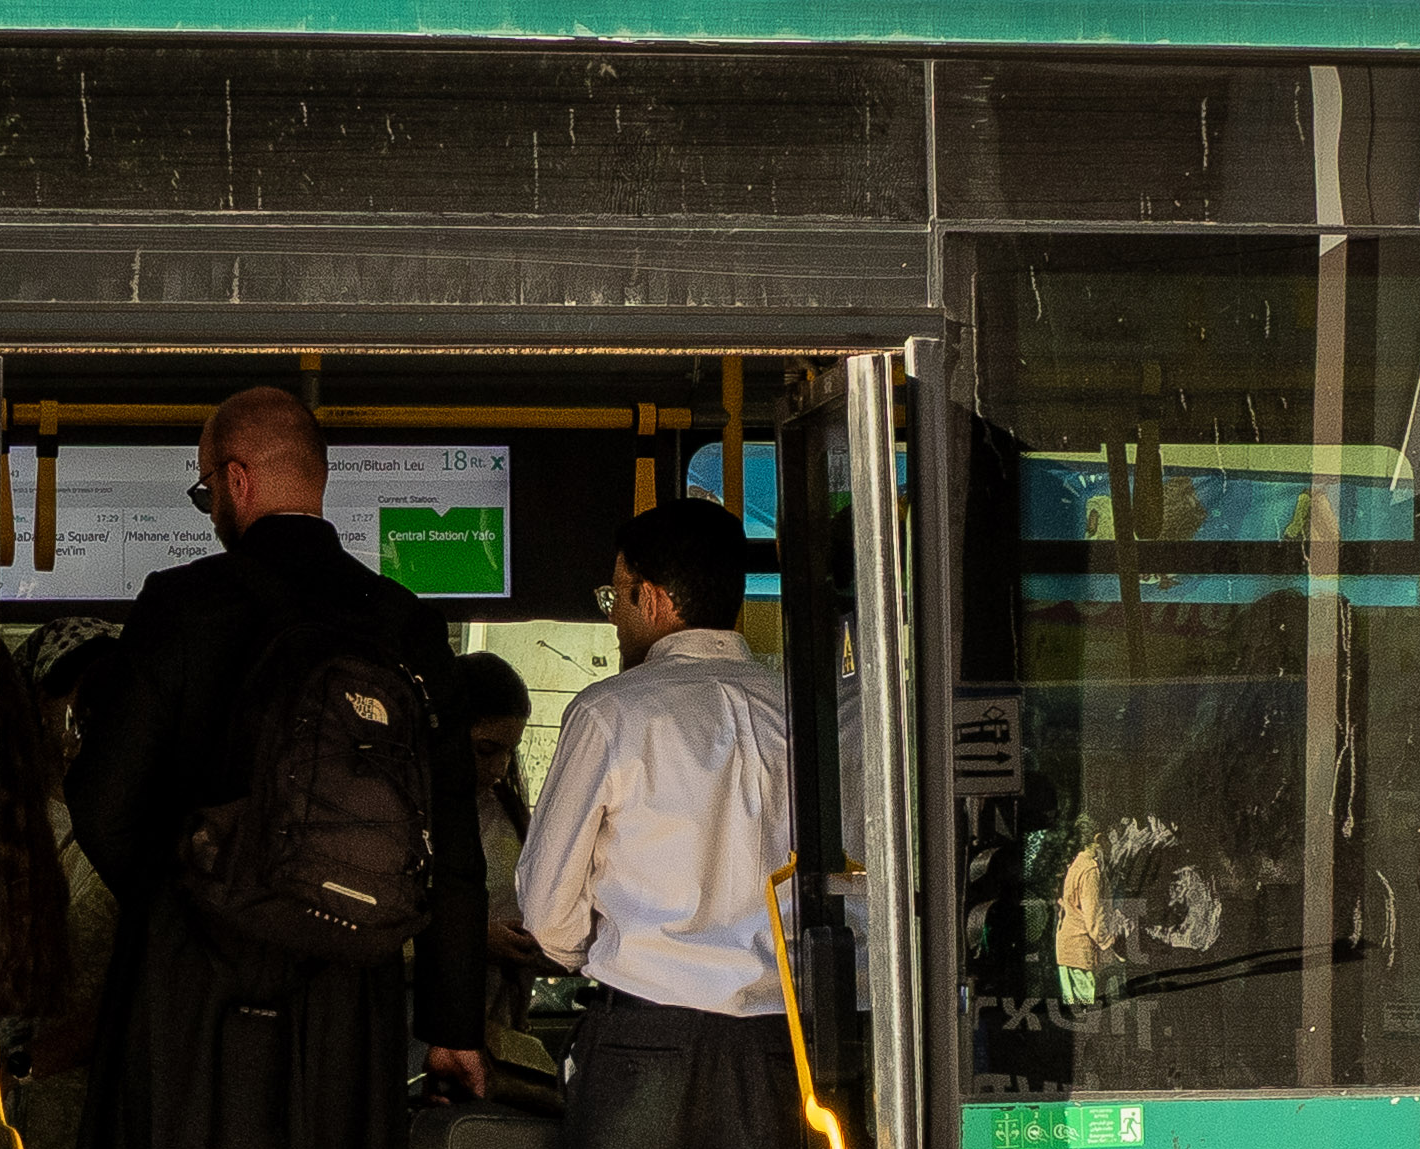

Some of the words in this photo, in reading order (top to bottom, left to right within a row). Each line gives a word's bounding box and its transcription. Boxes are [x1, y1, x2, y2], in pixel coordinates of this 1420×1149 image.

[442, 450, 468, 471] 18
[68, 531, 109, 543] Square/
[173, 531, 212, 541] Yehuda
[388, 530, 425, 541] Central
[473, 530, 495, 541] Yafo
[168, 546, 207, 558] Agripas
